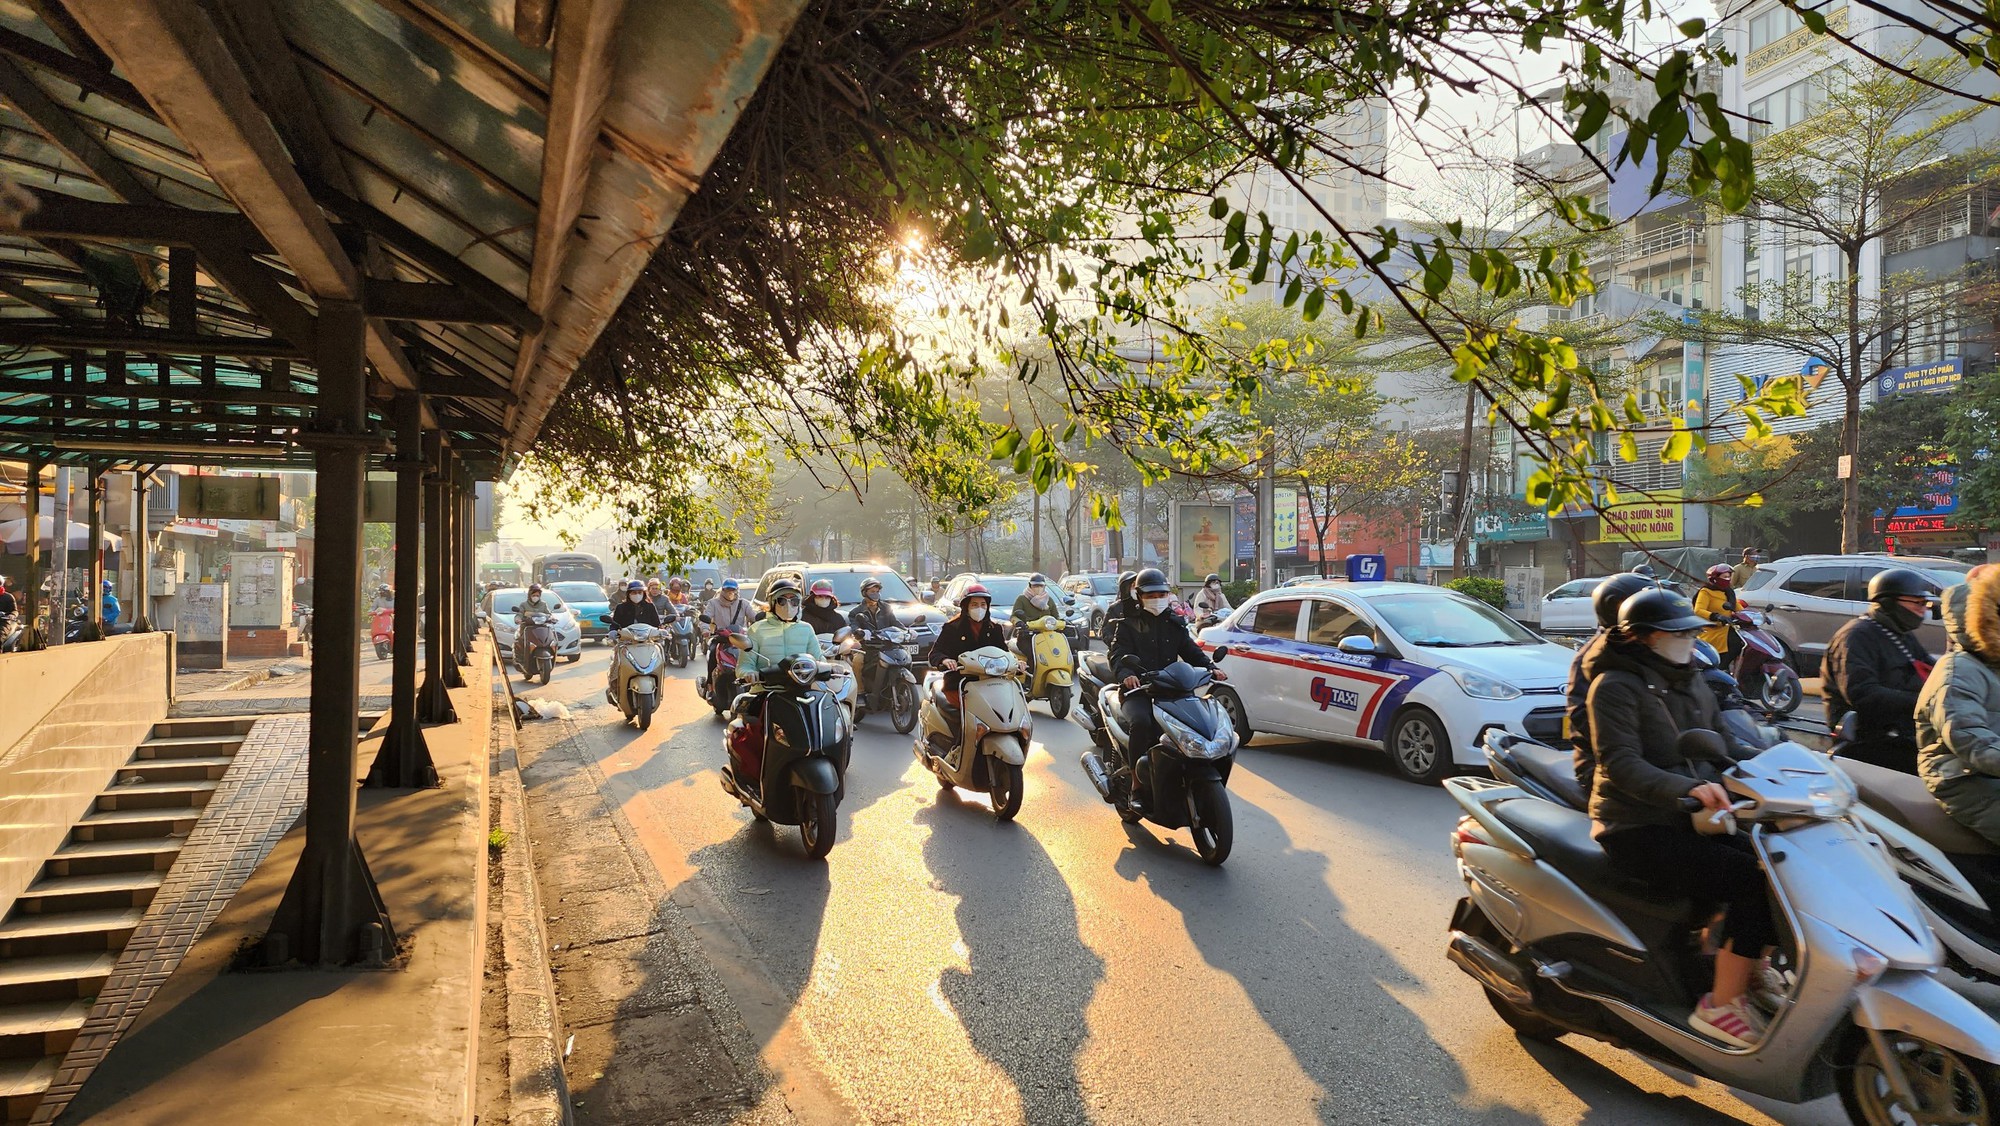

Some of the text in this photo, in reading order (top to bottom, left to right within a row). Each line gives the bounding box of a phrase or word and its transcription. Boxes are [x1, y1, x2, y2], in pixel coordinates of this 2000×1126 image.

[1920, 369, 1928, 377] TY
[1630, 508, 1653, 520] SƯỜN
[1655, 508, 1674, 521] SỤN
[1650, 521, 1674, 533] NÓNG
[1360, 557, 1378, 579] G7
[1332, 689, 1358, 706] TAXI
